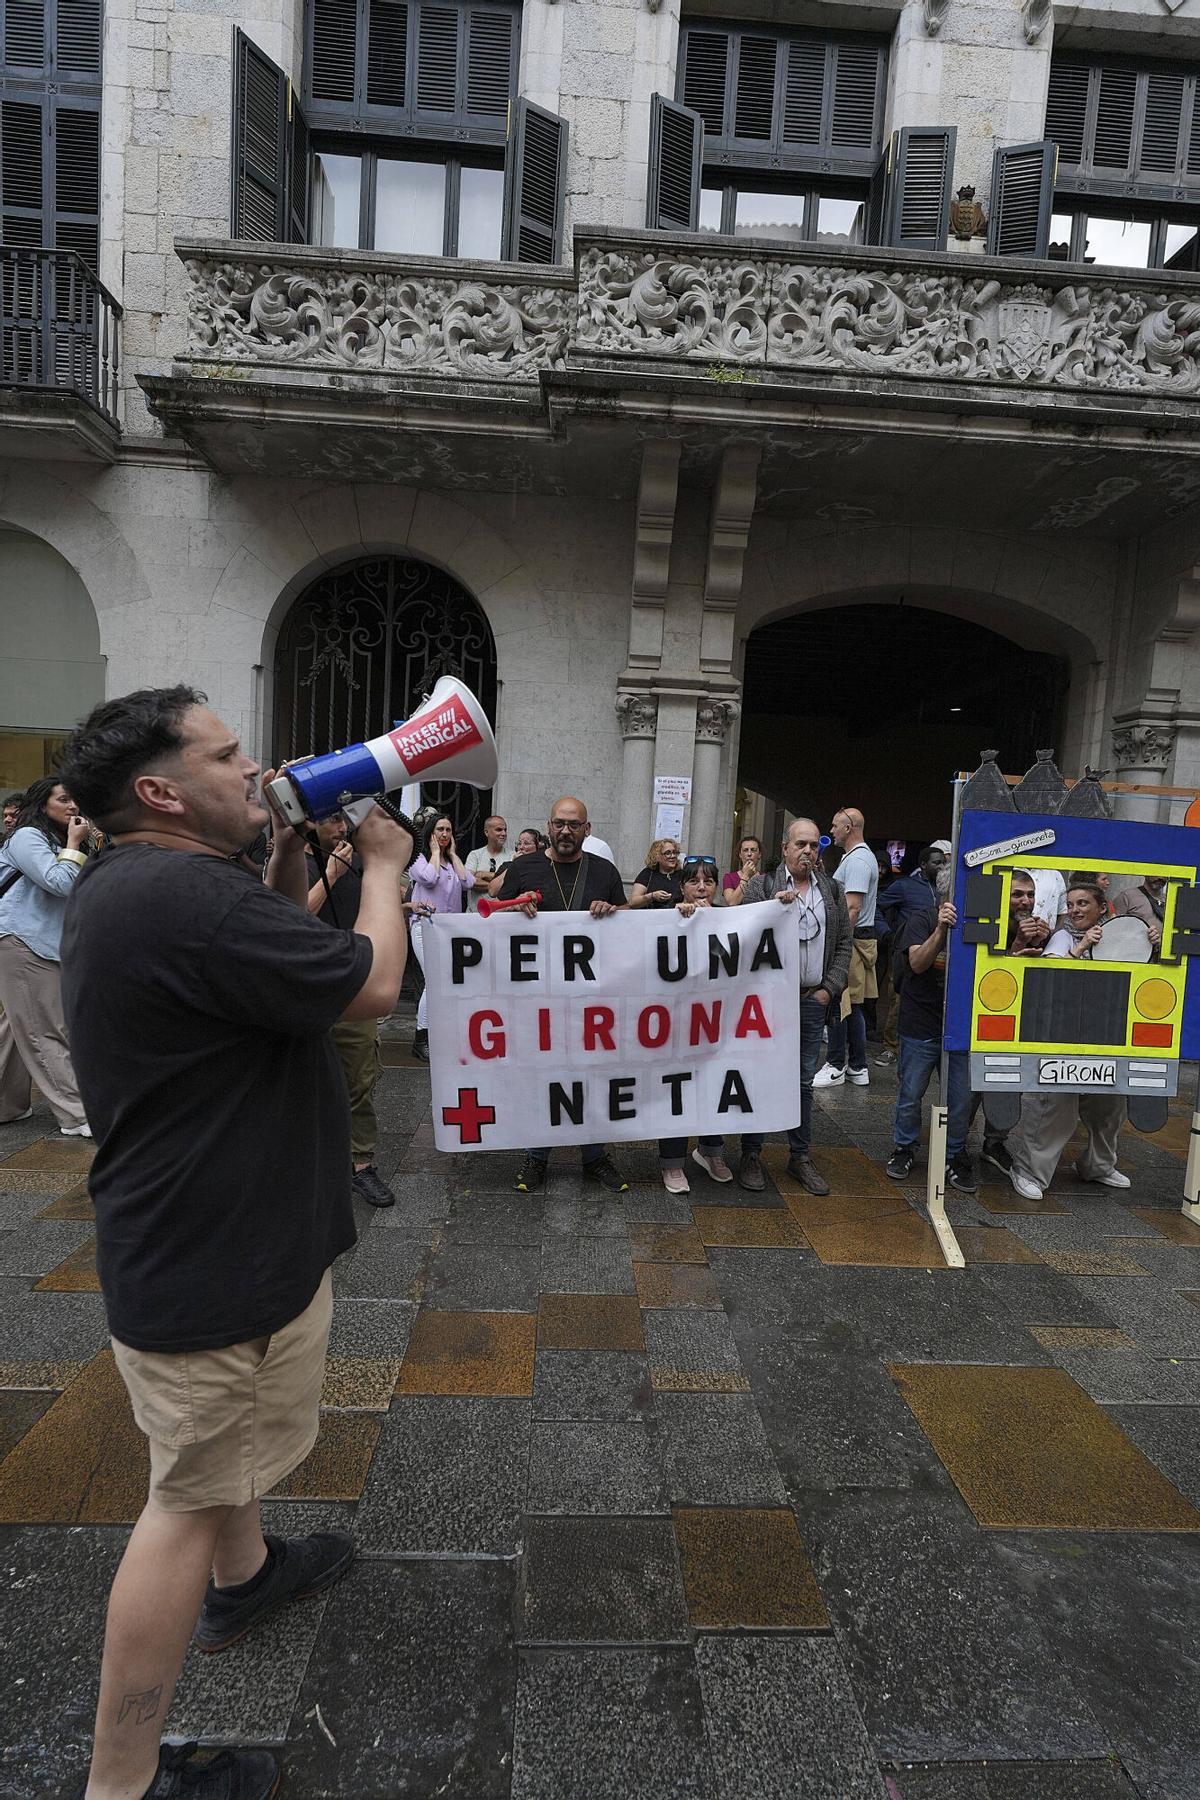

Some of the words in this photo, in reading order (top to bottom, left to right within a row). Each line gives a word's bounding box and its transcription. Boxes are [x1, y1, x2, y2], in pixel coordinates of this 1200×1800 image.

[397, 721, 441, 749] INTER
[402, 718, 472, 761] SINDICAL
[451, 935, 597, 985] PER
[657, 928, 784, 983] UNA
[468, 994, 772, 1060] GIRONA
[549, 1069, 754, 1127] NETA
